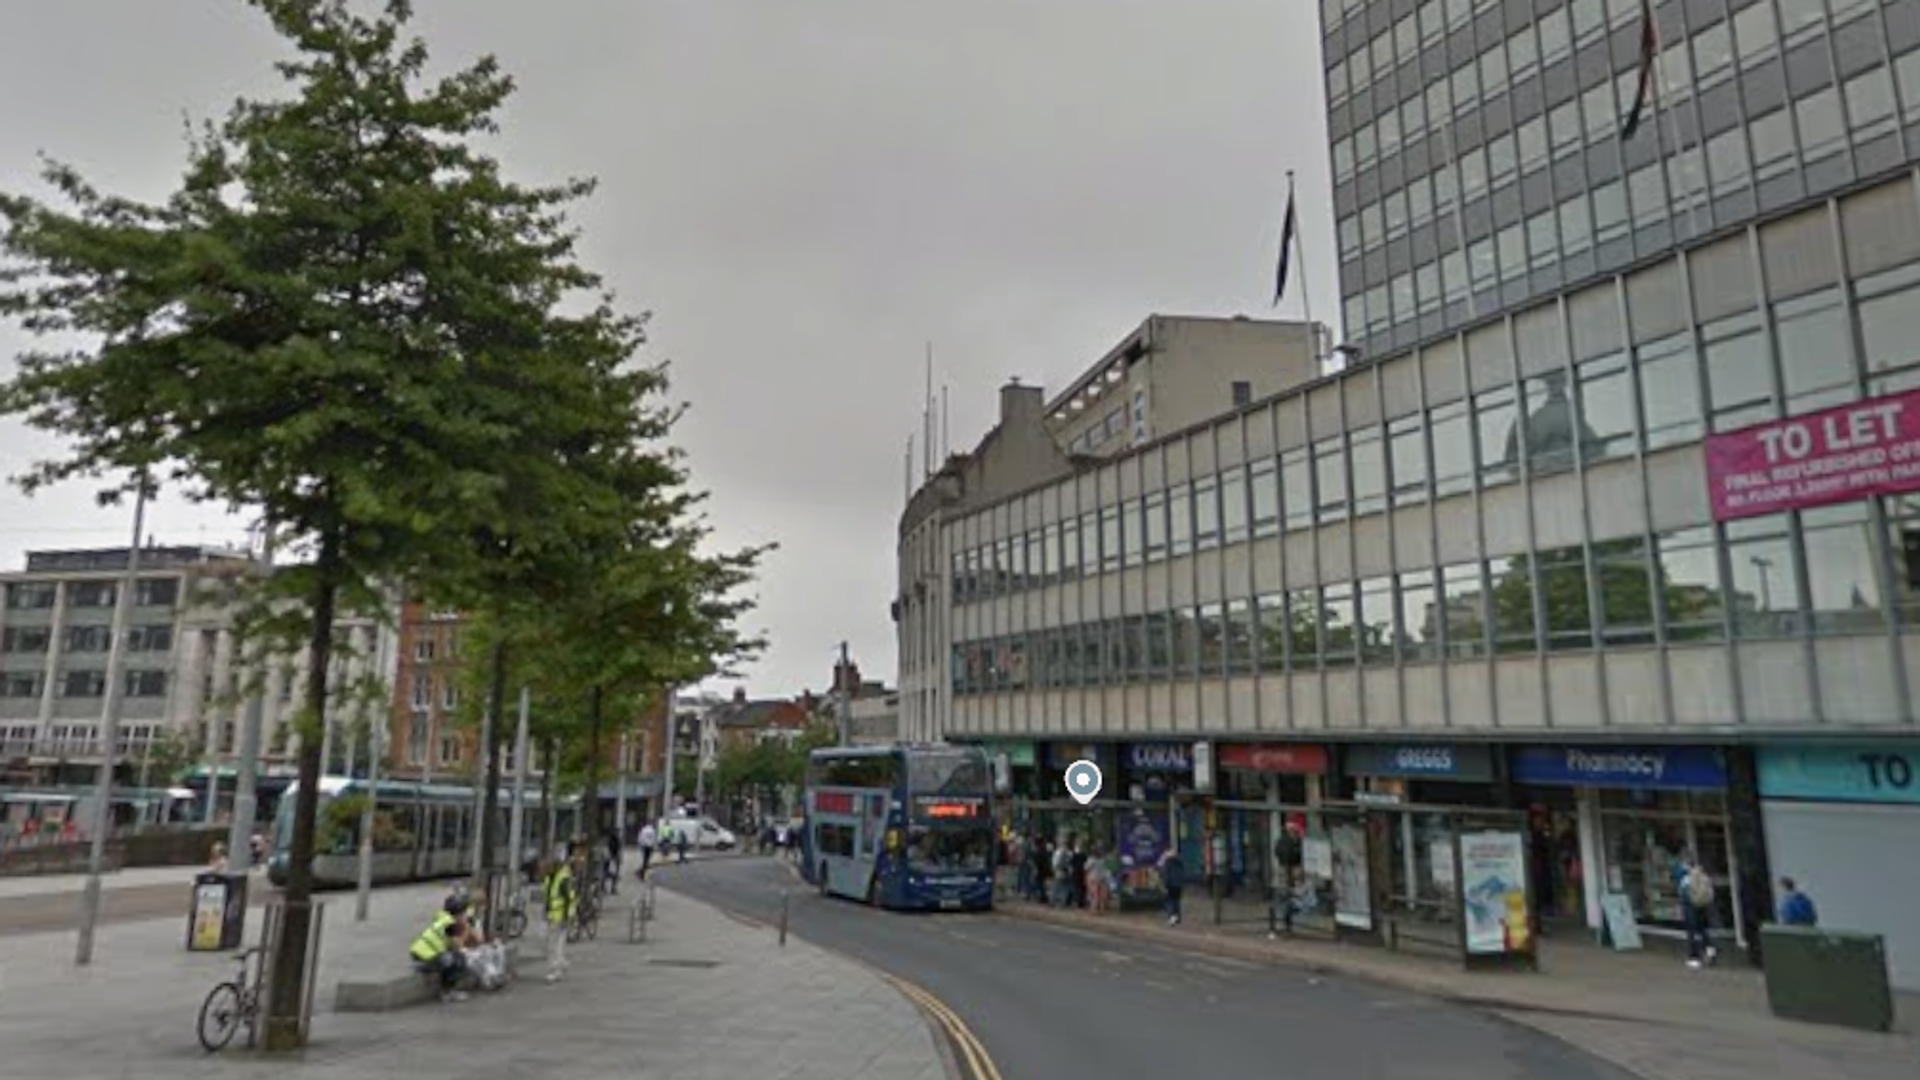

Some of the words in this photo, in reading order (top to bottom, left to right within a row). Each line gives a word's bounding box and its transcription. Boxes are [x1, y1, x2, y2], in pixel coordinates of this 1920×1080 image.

[1757, 423, 1811, 463] TO
[1823, 403, 1903, 450] LET
[1132, 745, 1188, 768] CORAL
[1397, 747, 1452, 769] GREGGS
[1565, 750, 1667, 780] Pharmacy
[1859, 753, 1912, 790] TO
